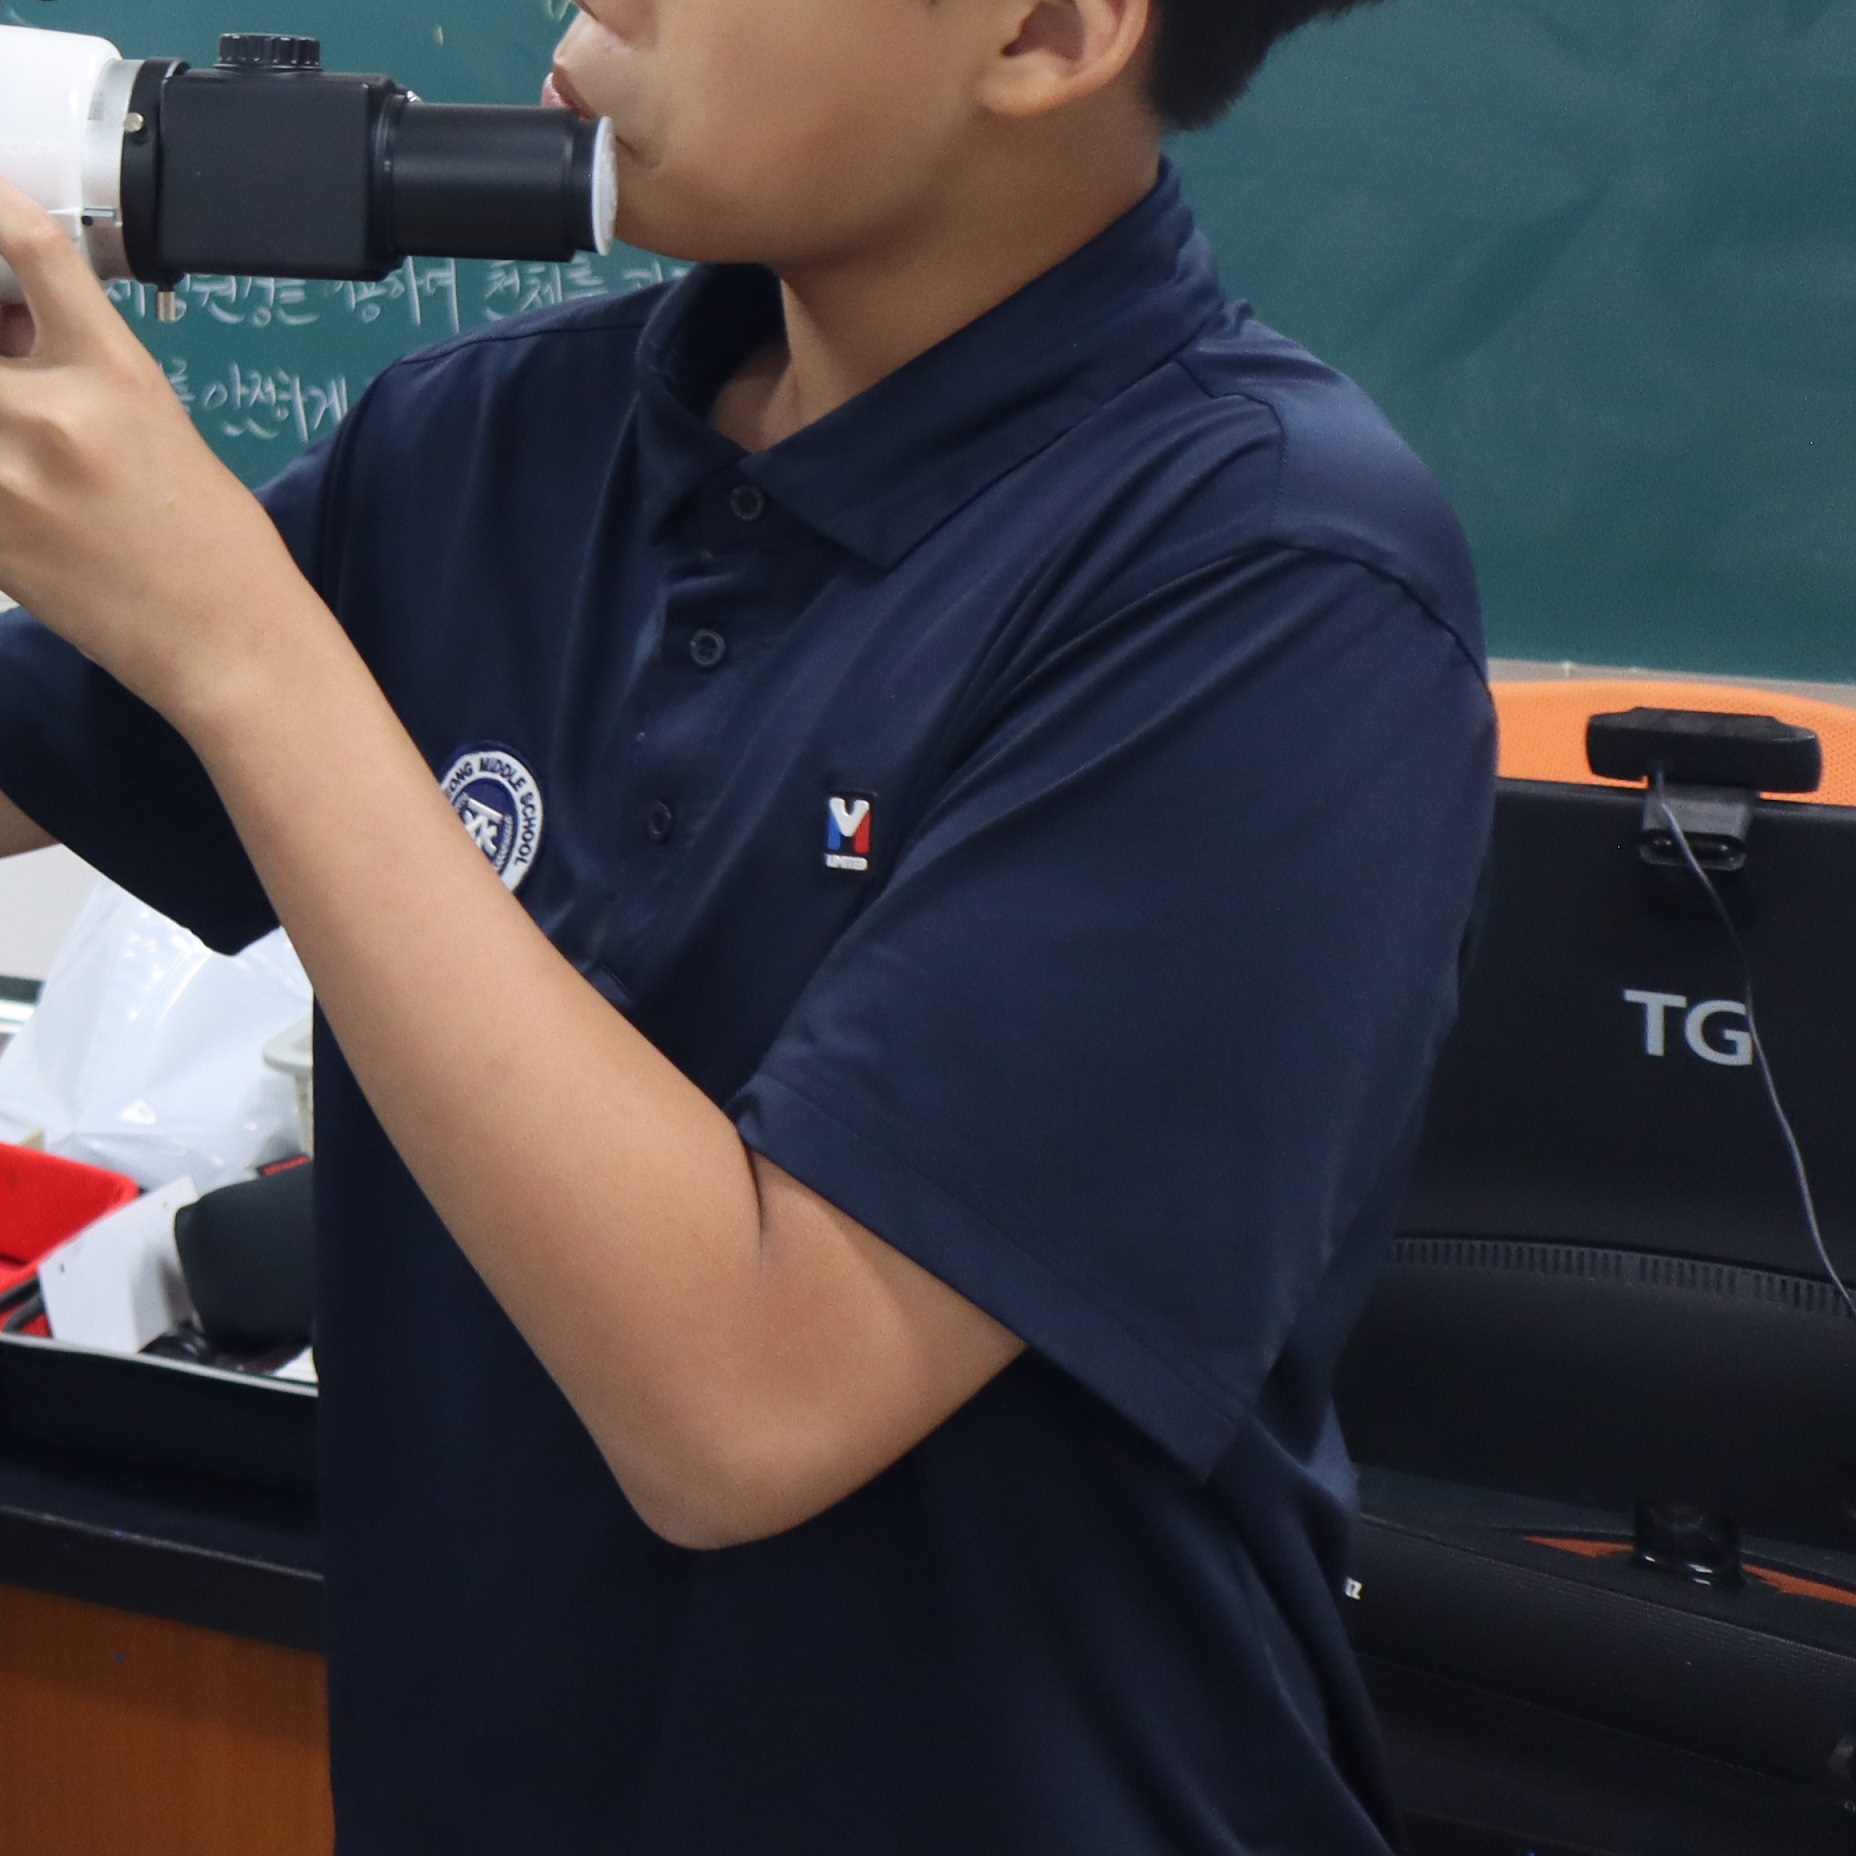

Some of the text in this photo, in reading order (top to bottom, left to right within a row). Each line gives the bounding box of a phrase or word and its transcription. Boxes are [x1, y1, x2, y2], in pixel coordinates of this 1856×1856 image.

[201, 360, 349, 443] 안전하게
[449, 757, 537, 867] ONG MIDDLE SCHOOL
[1623, 988, 1754, 1067] TG
